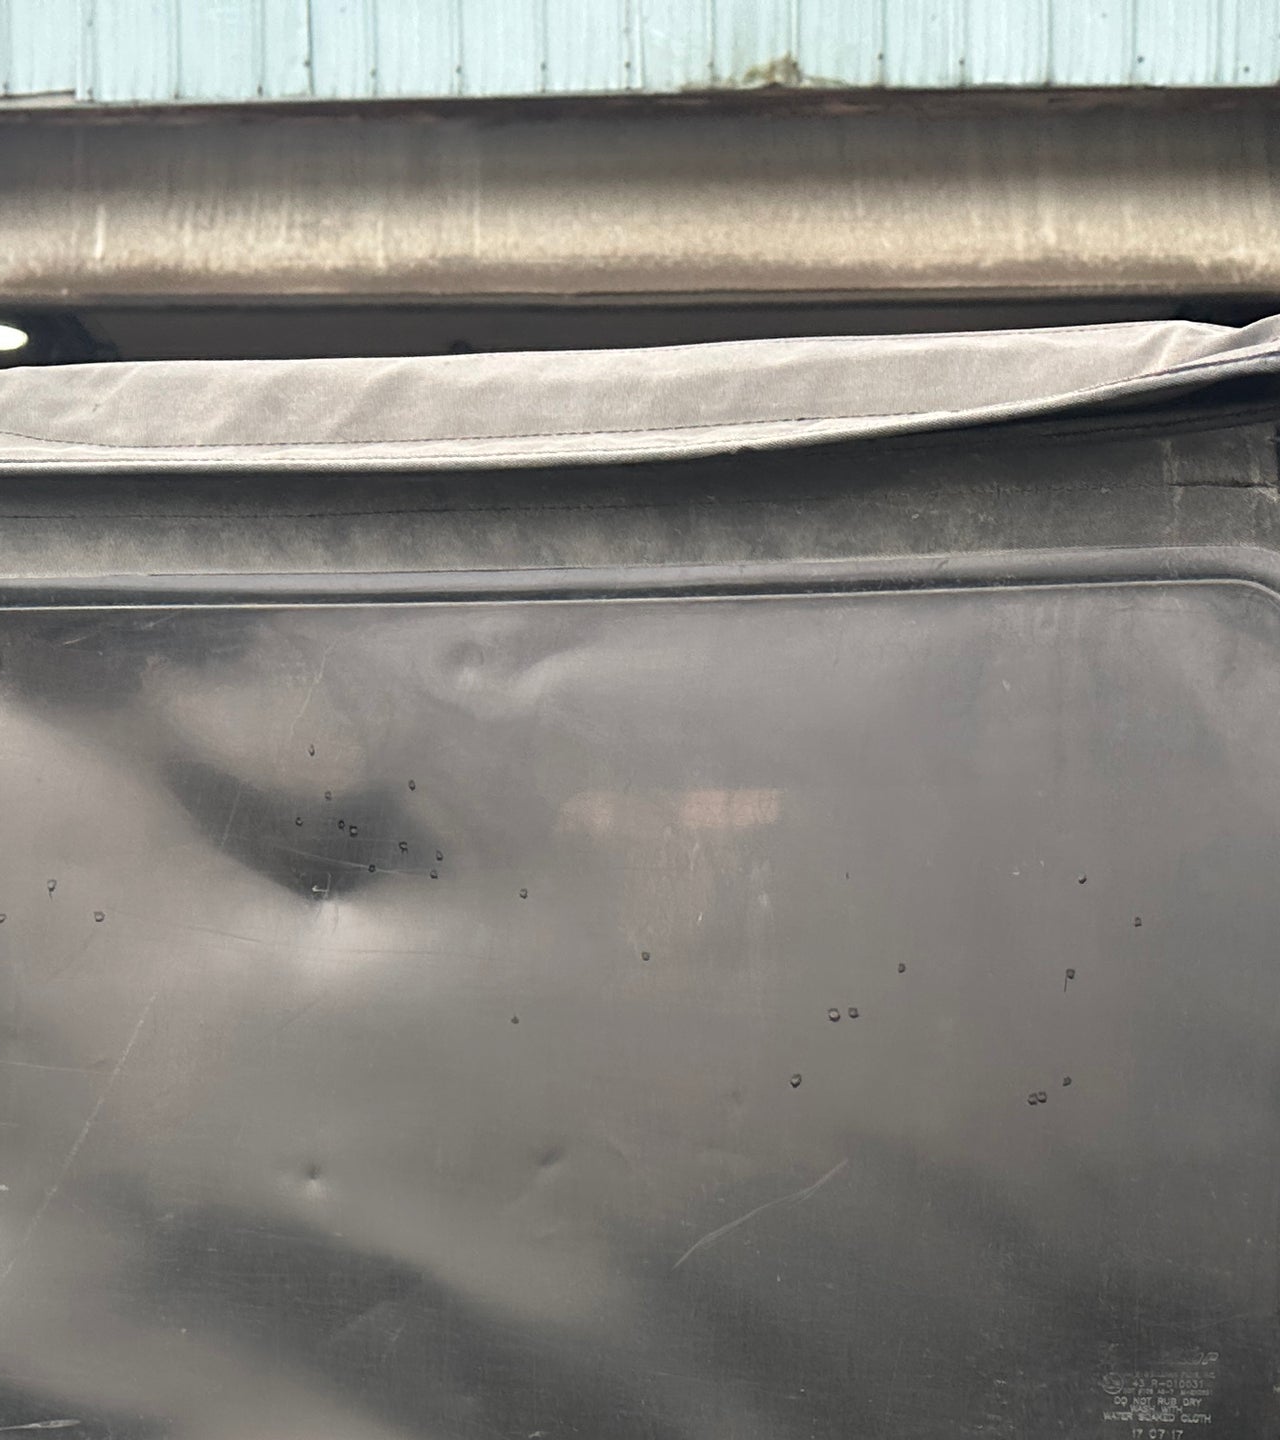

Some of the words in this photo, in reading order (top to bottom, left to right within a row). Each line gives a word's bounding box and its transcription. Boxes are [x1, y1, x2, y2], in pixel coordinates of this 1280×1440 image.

[1133, 1397, 1152, 1405] NOT
[1157, 1397, 1177, 1405] RUB
[1183, 1398, 1202, 1406] DRY
[1180, 1413, 1212, 1423] CLOTH
